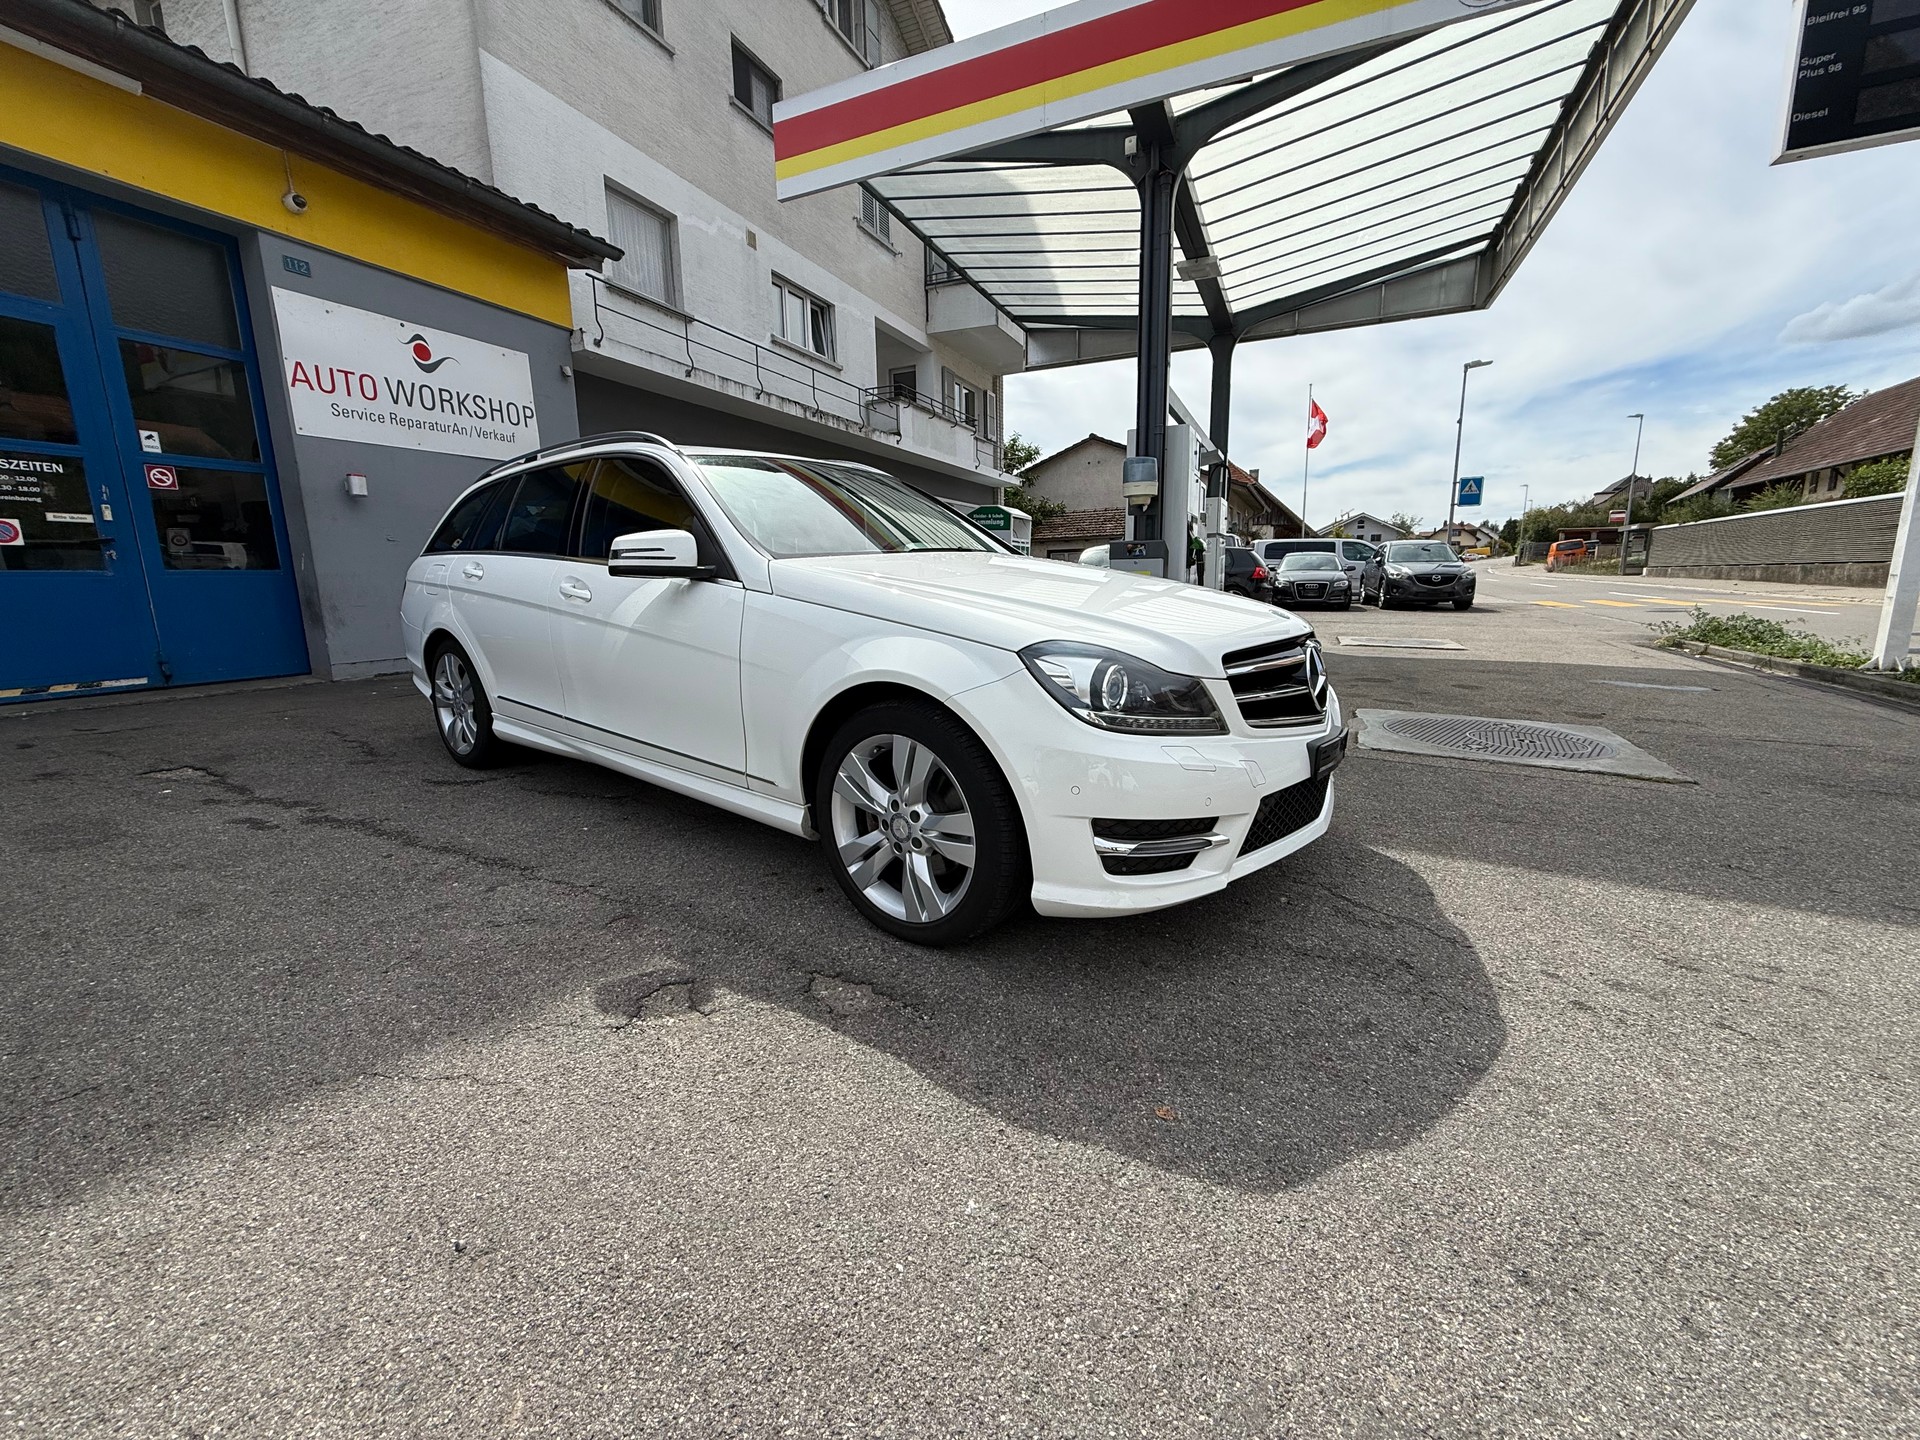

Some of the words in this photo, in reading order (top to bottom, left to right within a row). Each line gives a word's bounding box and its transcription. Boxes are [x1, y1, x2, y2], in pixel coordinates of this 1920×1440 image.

[1806, 8, 1850, 26] Bleifrei
[1852, 4, 1868, 15] 95
[1801, 52, 1837, 67] Super
[1799, 68, 1825, 79] Plus
[1828, 62, 1843, 73] 98
[1792, 107, 1829, 122] Diesel
[286, 257, 309, 275] 112
[290, 360, 379, 402] AUTO
[383, 376, 535, 428] WORKSHOP
[330, 402, 386, 424] Service
[0, 458, 64, 474] SZEITEN
